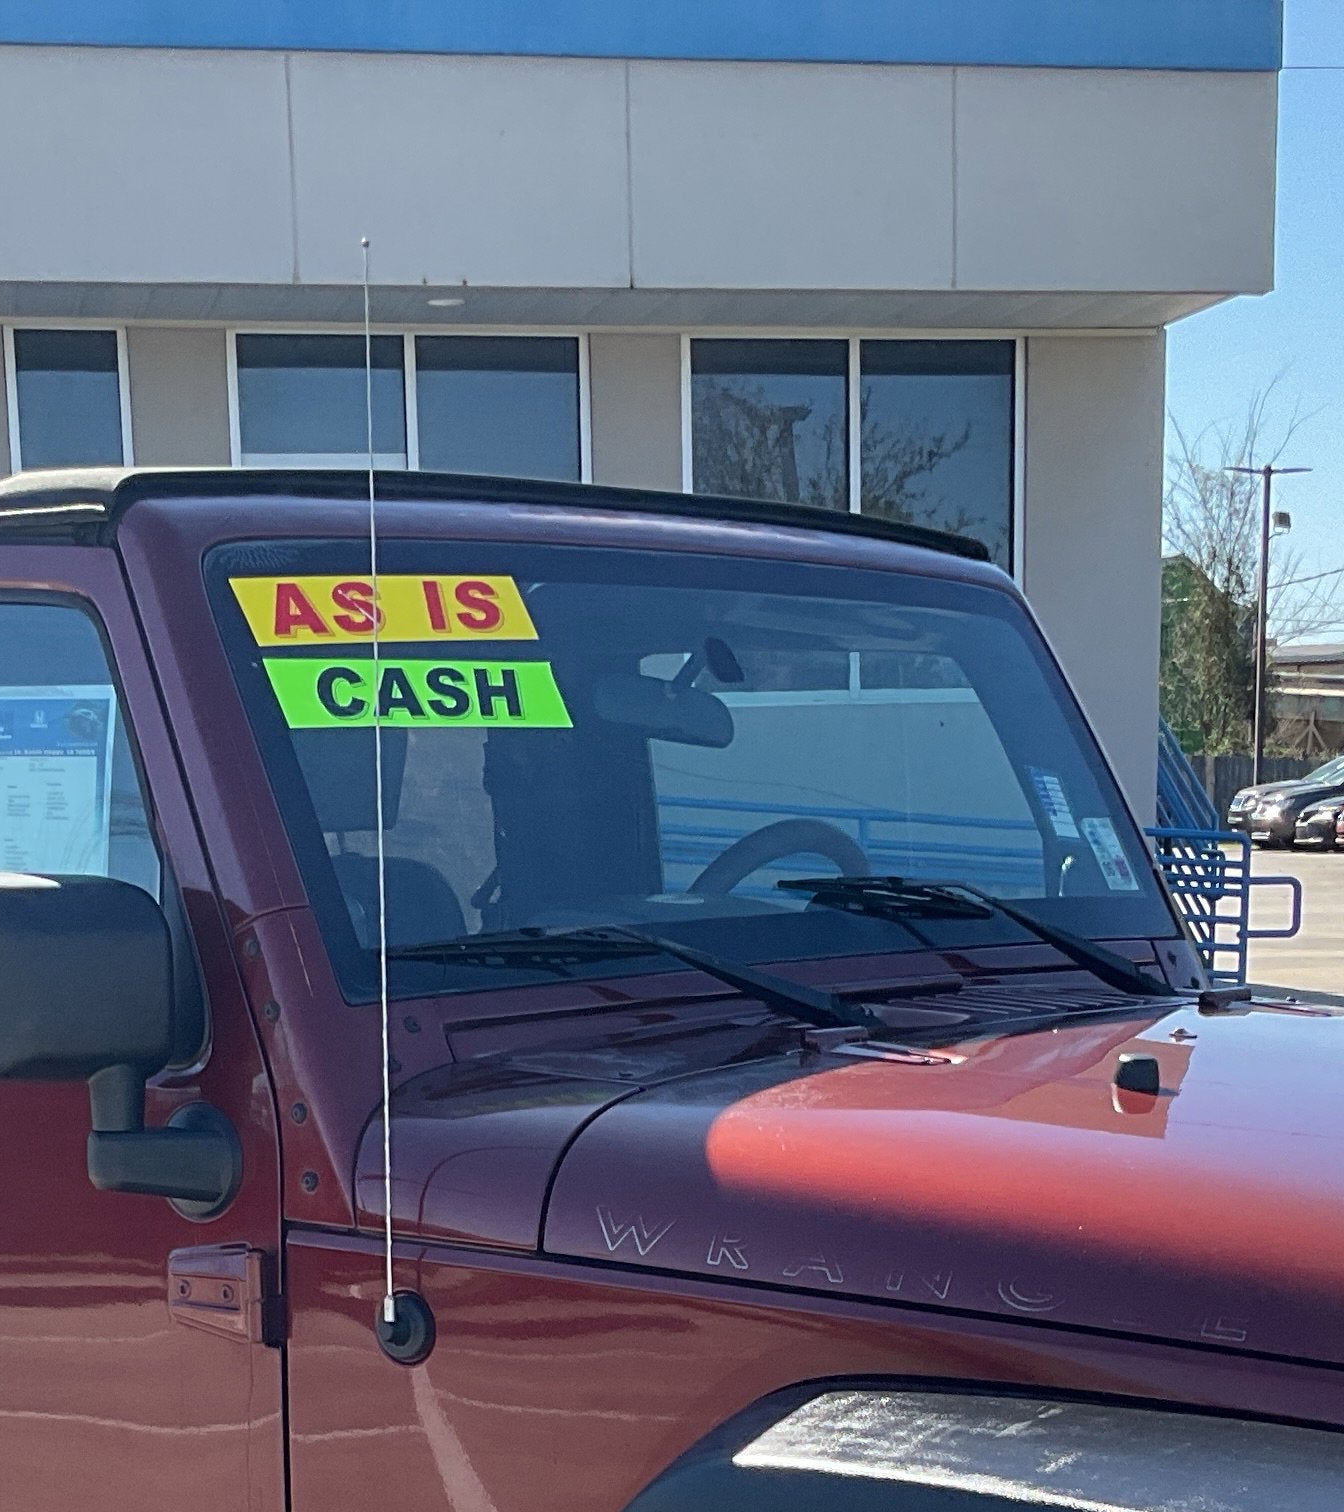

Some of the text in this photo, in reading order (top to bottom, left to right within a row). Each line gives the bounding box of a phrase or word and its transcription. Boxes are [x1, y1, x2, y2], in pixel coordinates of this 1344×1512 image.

[274, 580, 506, 638] AS IS
[316, 665, 525, 721] CASH
